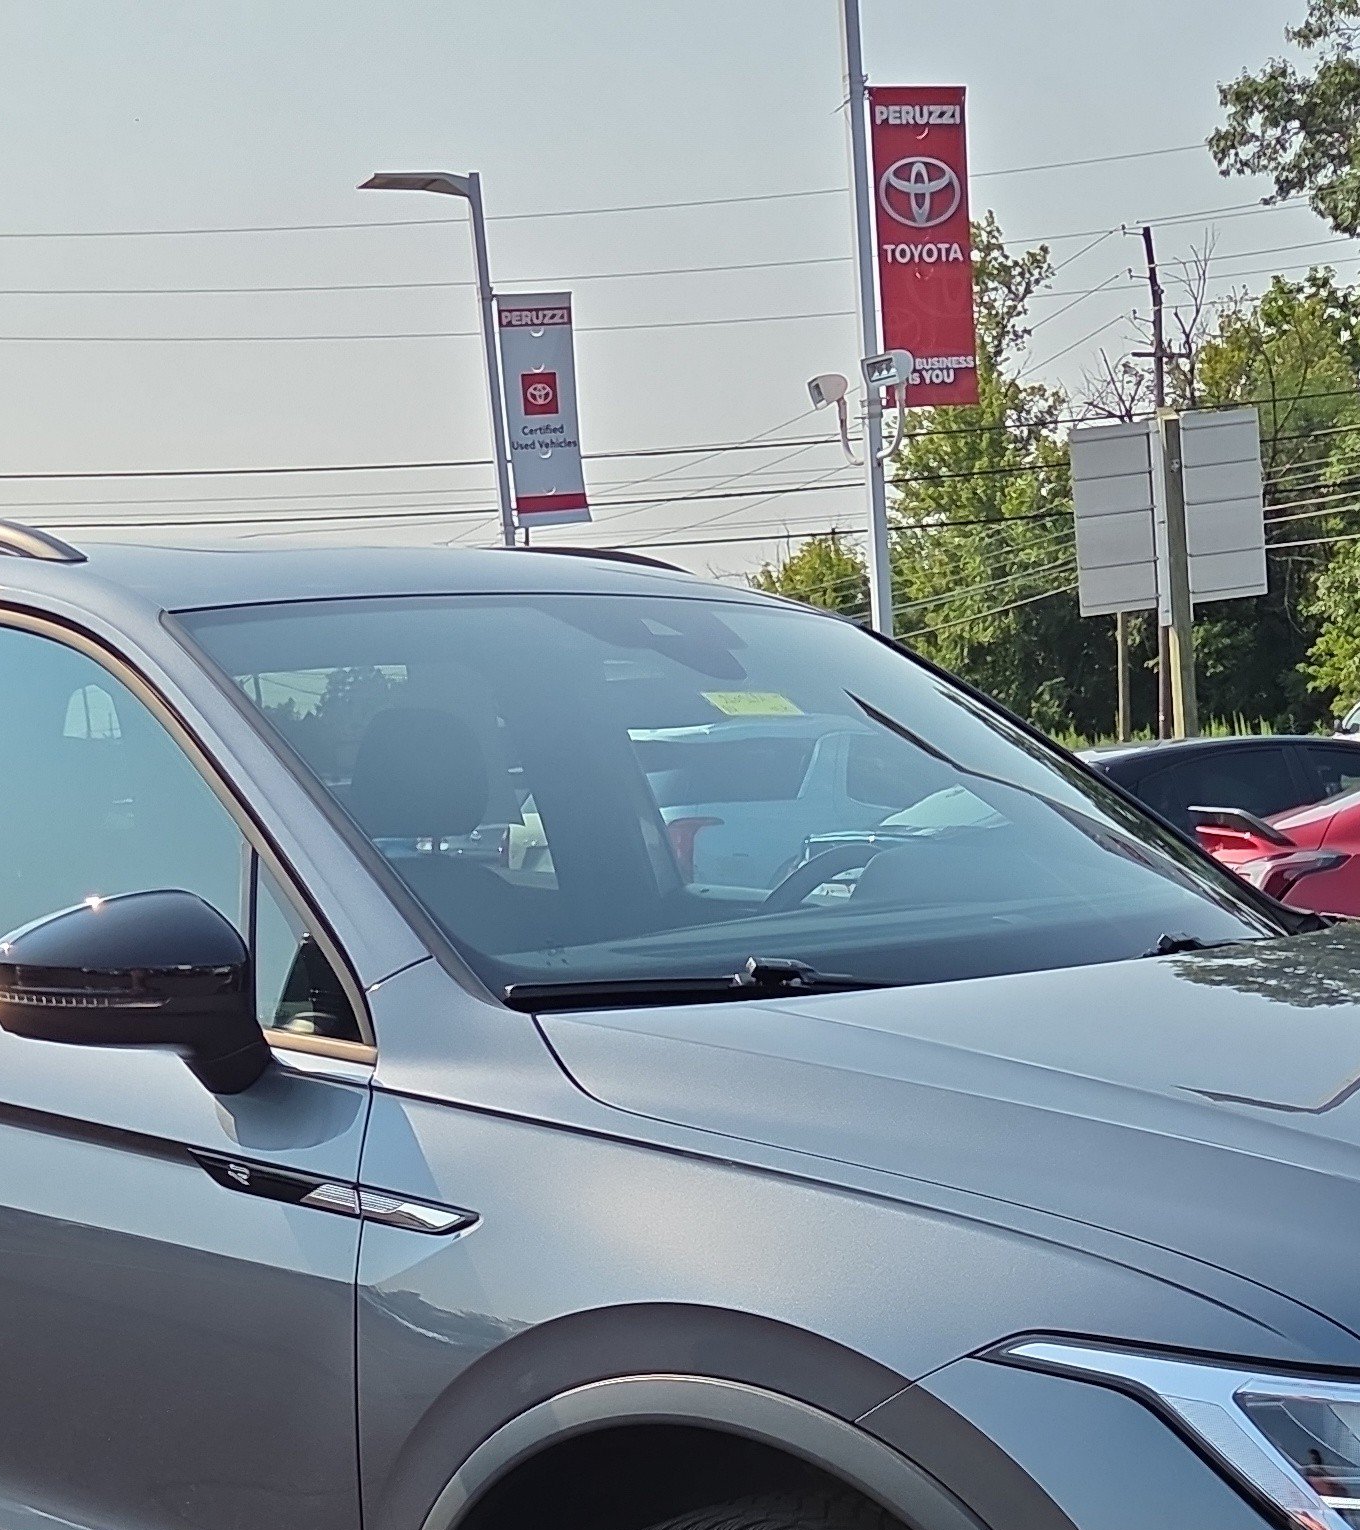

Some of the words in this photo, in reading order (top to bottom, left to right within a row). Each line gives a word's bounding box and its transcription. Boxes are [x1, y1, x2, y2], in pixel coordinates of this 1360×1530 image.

[875, 105, 961, 125] PERUZZI
[882, 242, 964, 264] TOYOTA
[501, 310, 568, 325] PERUZZI
[915, 356, 975, 370] BUSINESS
[922, 368, 955, 385] YOU
[521, 424, 565, 436] Certified
[511, 440, 536, 451] Used
[538, 438, 578, 450] Vehicles
